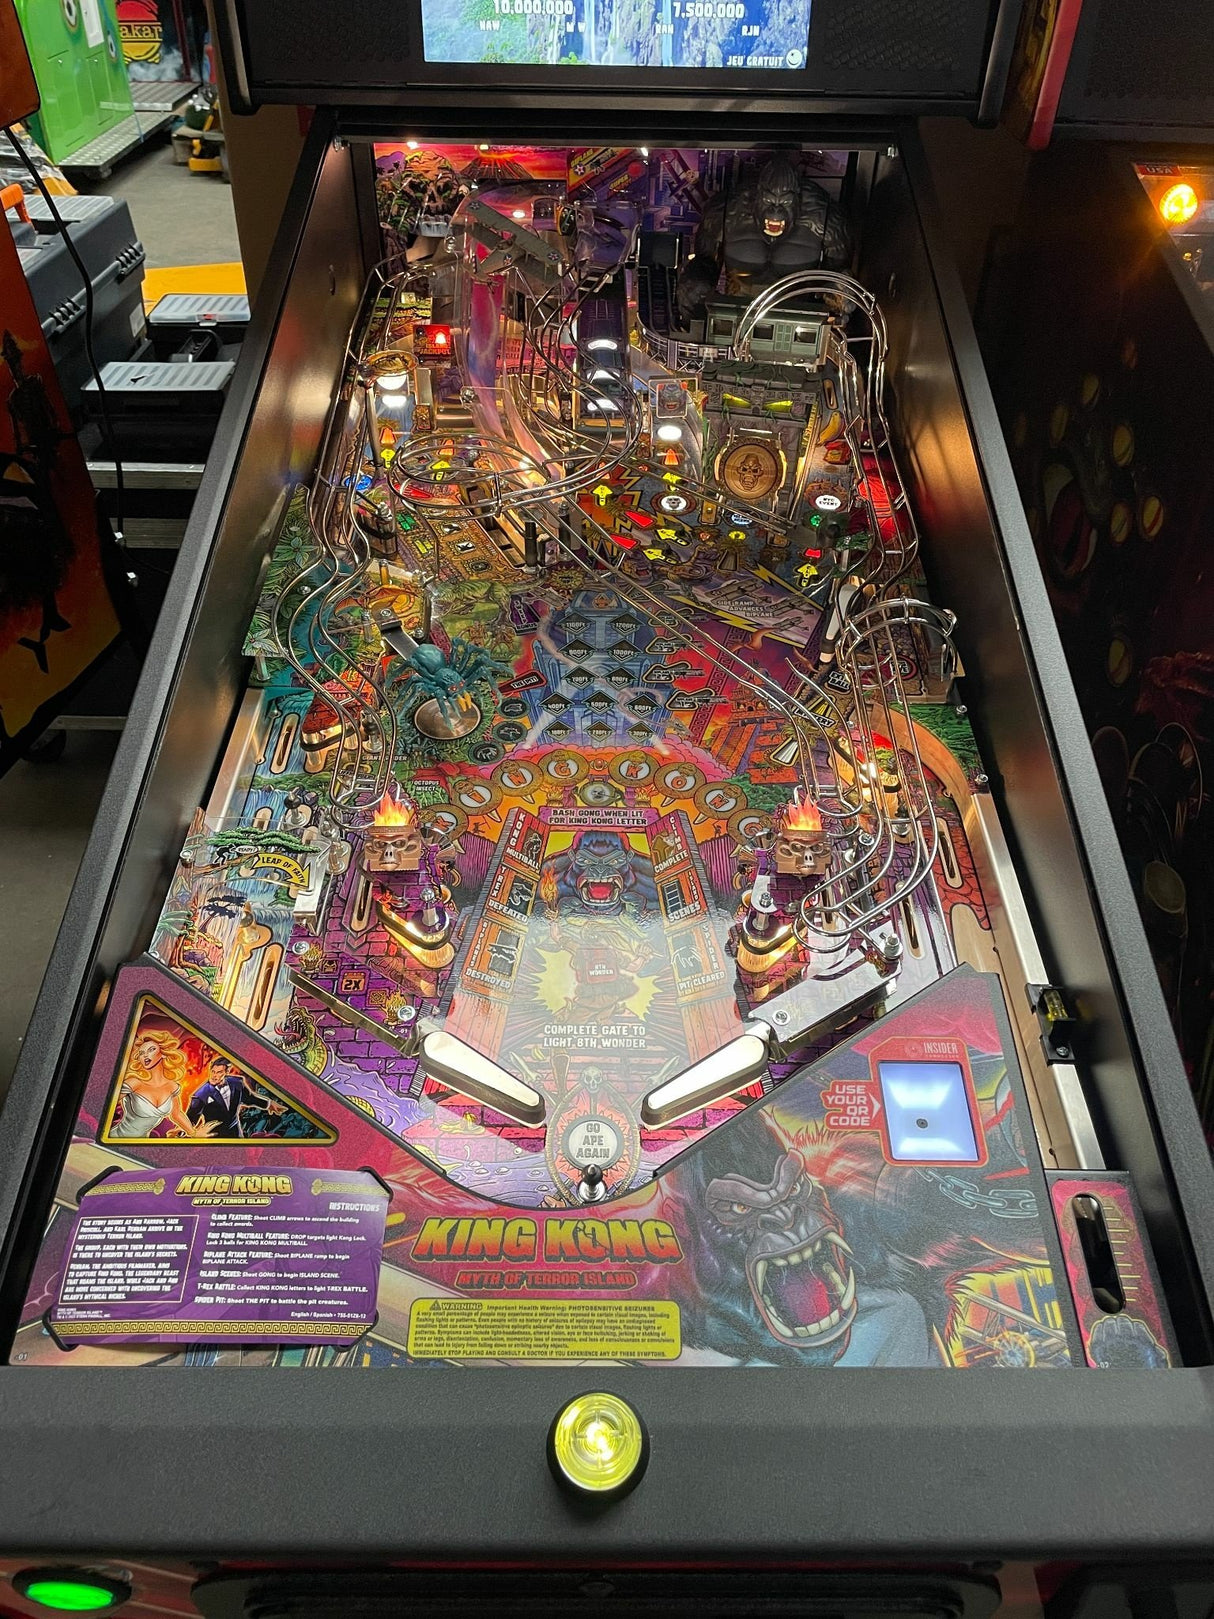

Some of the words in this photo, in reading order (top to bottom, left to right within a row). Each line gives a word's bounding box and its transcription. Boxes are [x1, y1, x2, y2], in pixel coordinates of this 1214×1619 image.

[673, 3, 745, 19] 7,500,000
[479, 20, 500, 31] NAW
[656, 24, 674, 35] RAN
[741, 25, 760, 36] RJN
[120, 24, 163, 40] akar
[727, 56, 744, 66] JEU
[746, 56, 784, 66] GRATUIT
[1147, 167, 1173, 175] USA
[552, 809, 575, 817] BASH
[591, 817, 612, 825] KONG
[510, 812, 526, 847] KONG
[669, 816, 681, 851] CLIMB
[506, 847, 539, 869] MULTIBALL
[654, 850, 688, 874] COMPLETE
[262, 856, 282, 865] LEAP
[282, 861, 293, 870] OF
[292, 867, 306, 884] FAITH
[488, 899, 528, 923] DEFEATED
[668, 901, 700, 922] SCENES
[702, 925, 718, 970] SPIDER
[465, 968, 512, 989] DESTROYED
[678, 978, 690, 990] PIT
[693, 971, 725, 986] CLEARED
[344, 979, 362, 990] 2X
[544, 1025, 598, 1035] COMPLETE
[602, 1025, 628, 1035] GATE
[632, 1026, 646, 1035] TO
[543, 1037, 572, 1047] LIGHT
[577, 1038, 597, 1048] 8TH
[601, 1038, 646, 1048] WONDER
[923, 1042, 958, 1054] INSIDER
[835, 1085, 866, 1094] USE
[826, 1096, 867, 1105] YOUR
[846, 1106, 869, 1116] QR
[830, 1117, 870, 1126] CODE
[586, 1123, 601, 1133] GO
[582, 1136, 604, 1145] APE
[576, 1148, 610, 1158] AGAIN
[175, 1175, 230, 1196] KING
[232, 1175, 293, 1196] KONG
[193, 1197, 211, 1205] MYTH
[213, 1197, 222, 1205] OF
[223, 1197, 245, 1205] TERROR
[246, 1197, 270, 1205] ISLAND
[329, 1202, 380, 1212] INSTRUCTIONS
[411, 1217, 537, 1263] KING
[544, 1217, 684, 1263] KONG
[456, 1271, 499, 1289] MYTH
[503, 1271, 523, 1289] OF
[525, 1271, 580, 1289] TERROR
[583, 1271, 637, 1289] ISLAND
